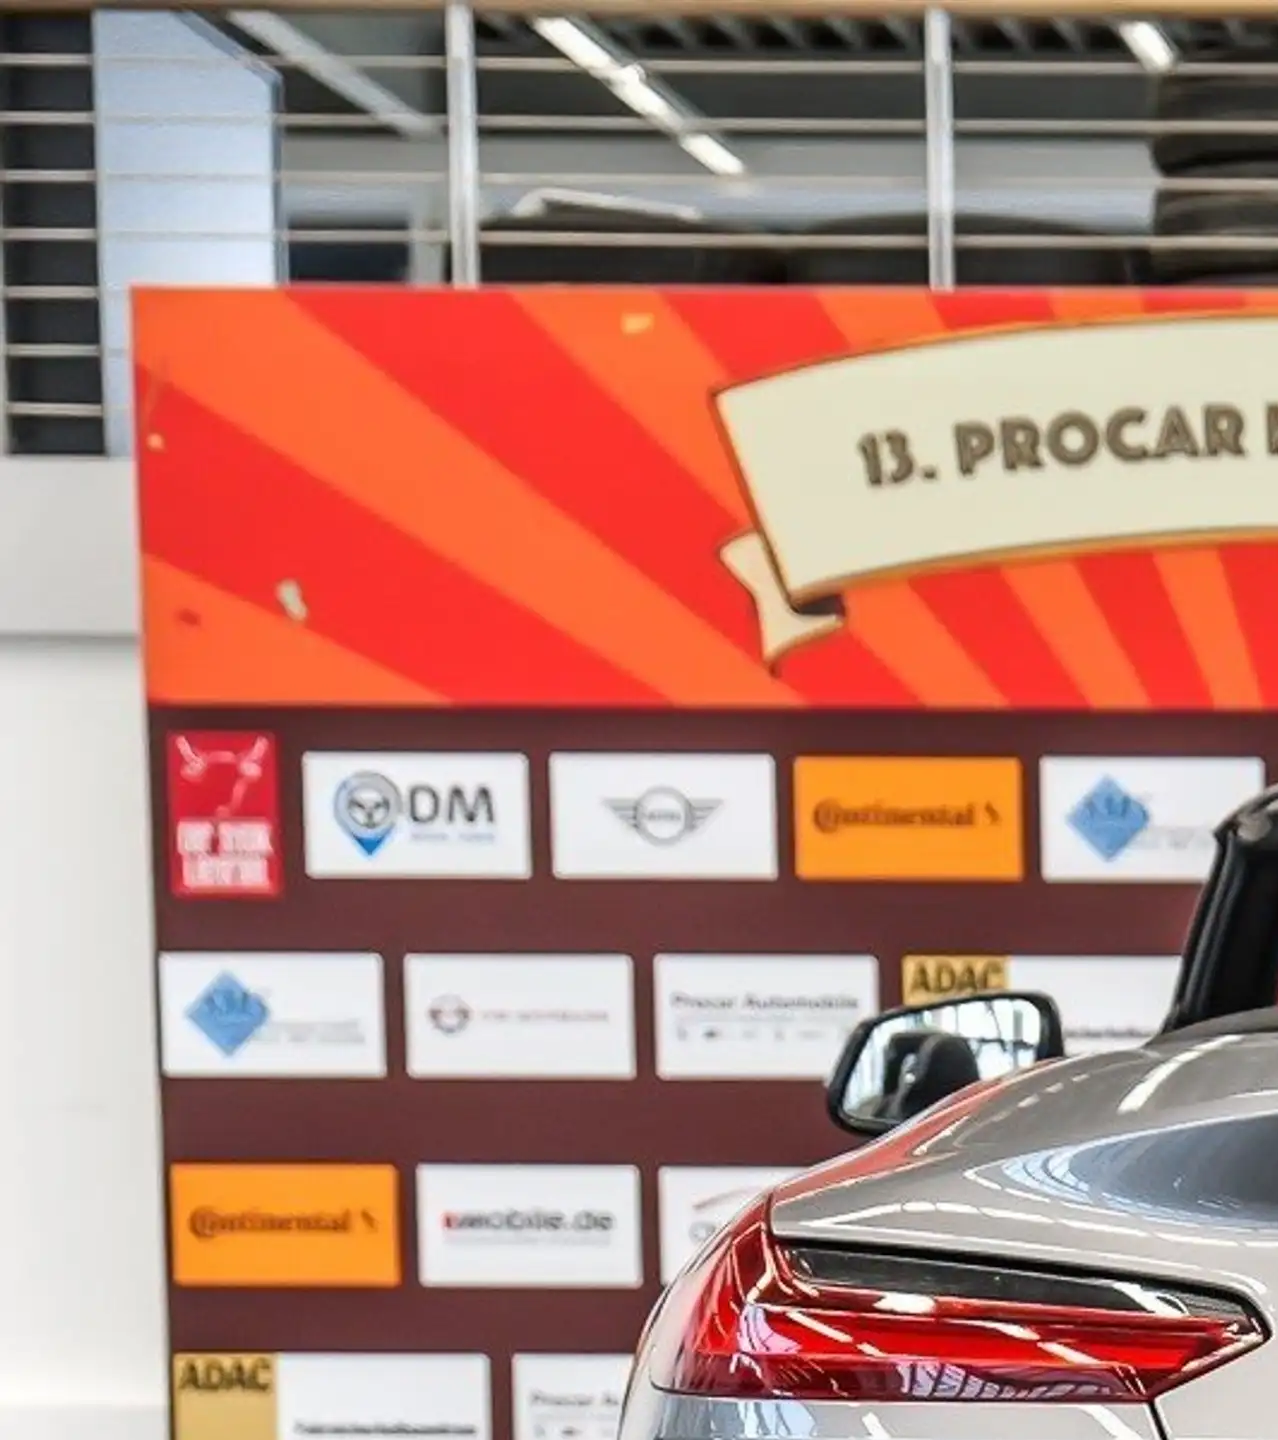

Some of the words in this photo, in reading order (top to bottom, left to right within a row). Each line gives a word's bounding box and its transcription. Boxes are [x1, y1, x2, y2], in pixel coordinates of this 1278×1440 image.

[858, 430, 938, 486] 13.
[954, 401, 1246, 476] PROCAR
[408, 784, 495, 824] DM
[911, 960, 1001, 993] ADAC
[180, 1360, 271, 1391] ADAC
